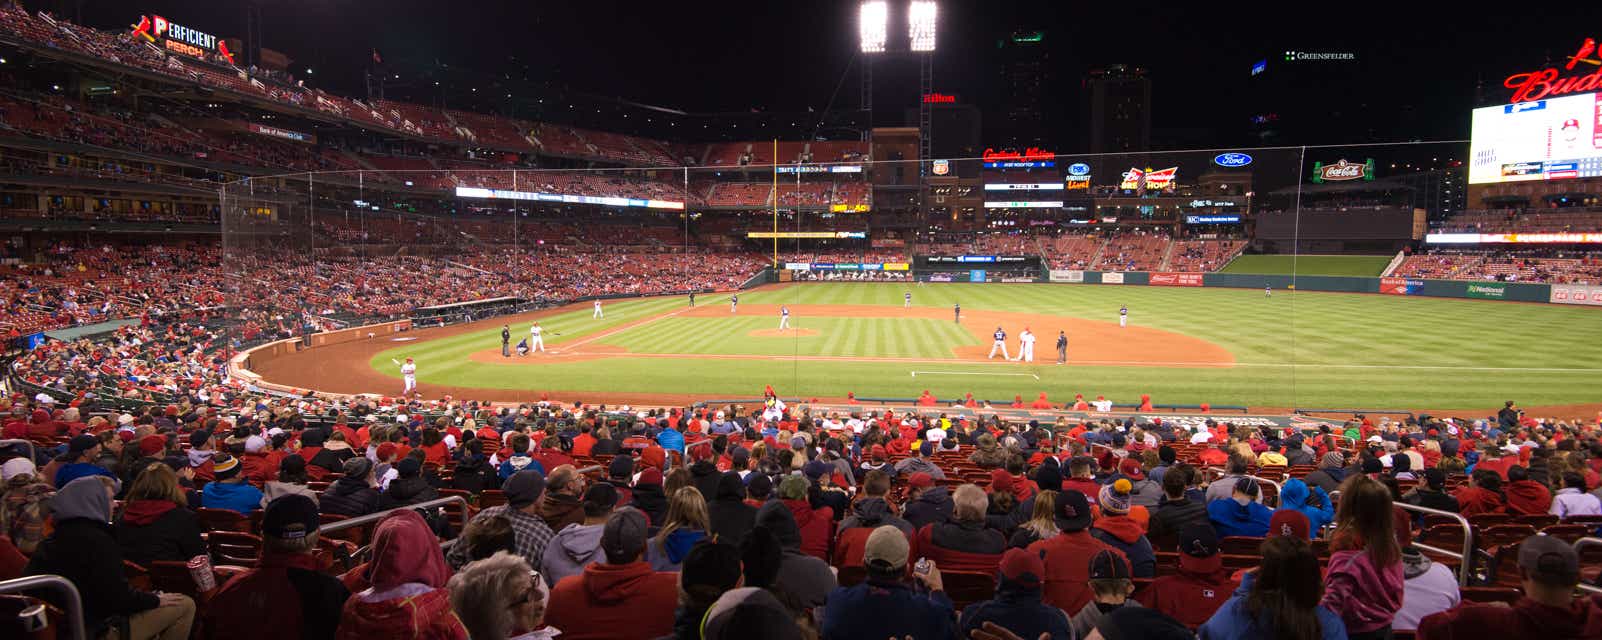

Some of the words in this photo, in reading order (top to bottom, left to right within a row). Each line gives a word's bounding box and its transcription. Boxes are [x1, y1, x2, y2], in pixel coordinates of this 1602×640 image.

[154, 16, 217, 50] PERFICIENT
[165, 39, 204, 57] PERCH
[1222, 154, 1246, 164] Ford
[1475, 285, 1504, 294] National
